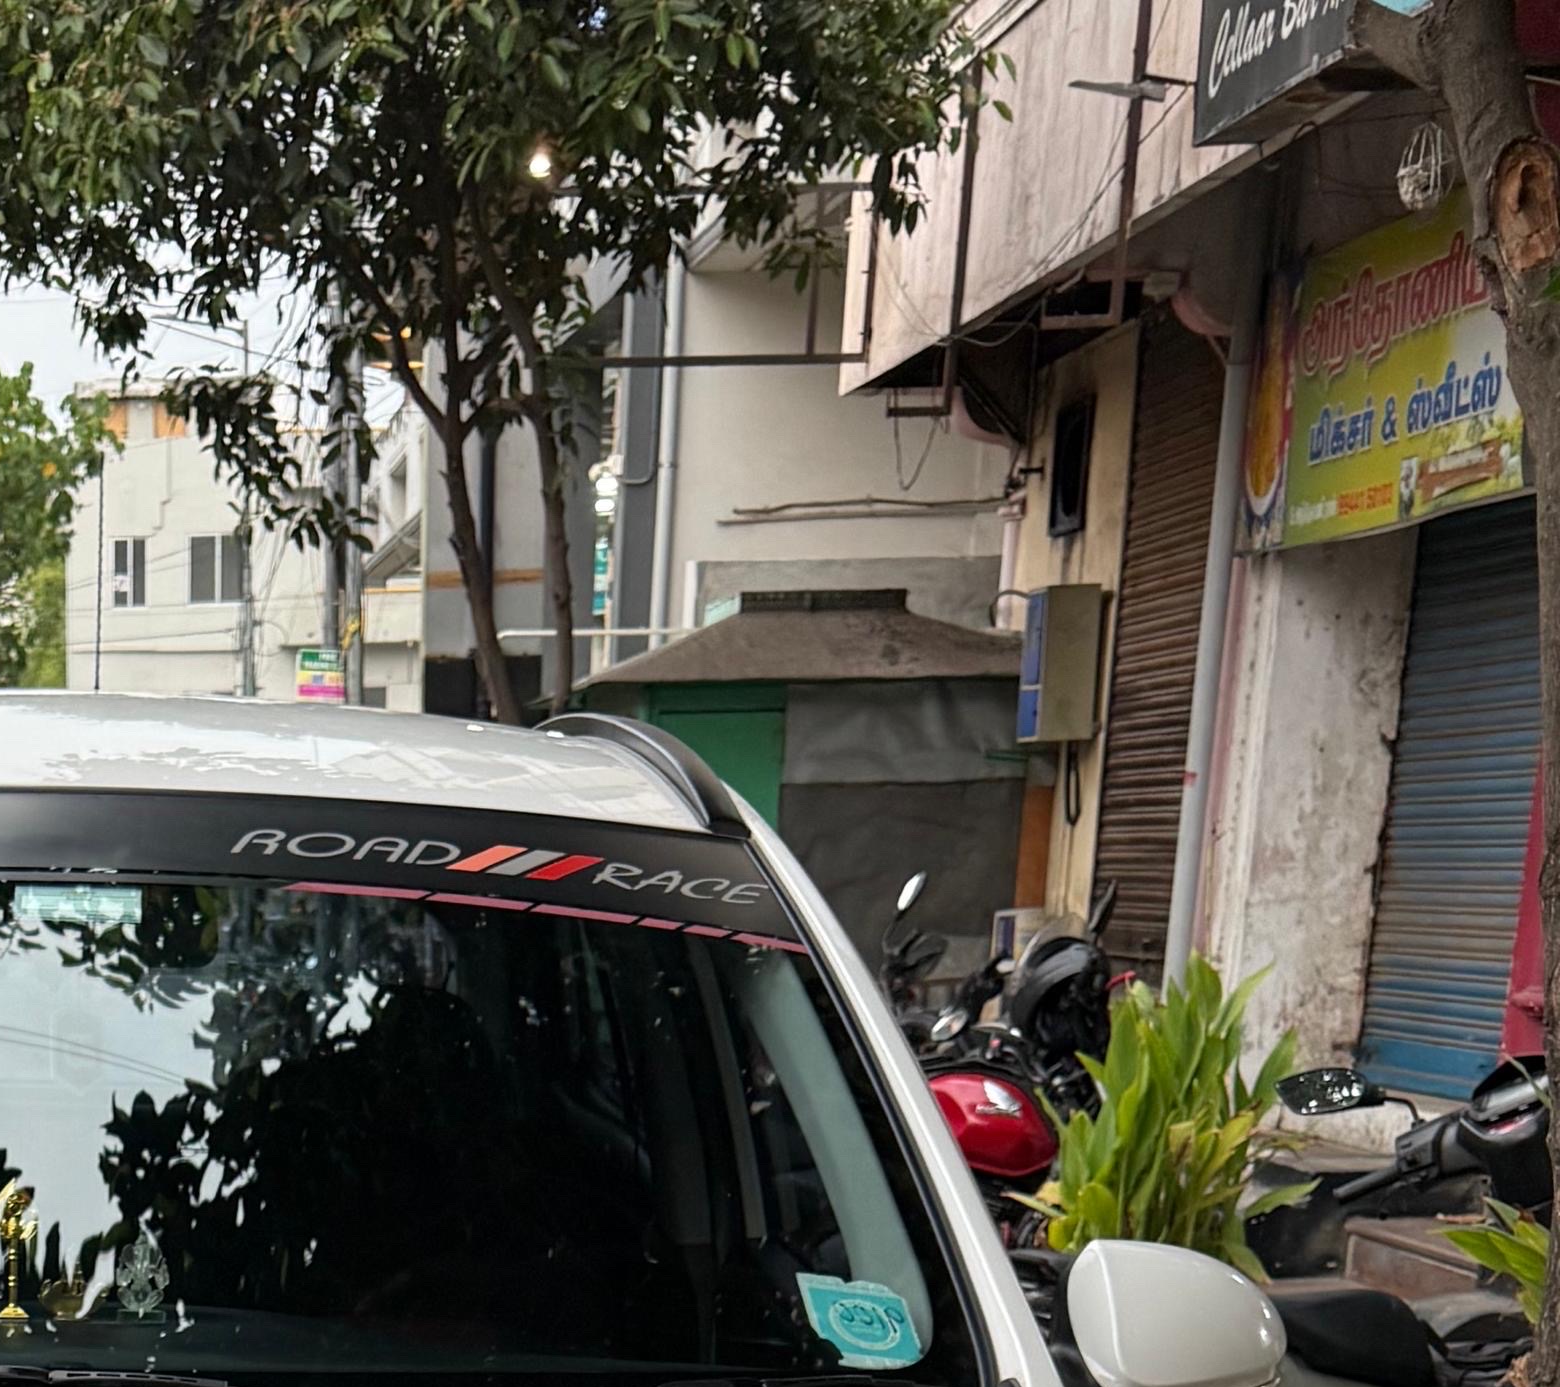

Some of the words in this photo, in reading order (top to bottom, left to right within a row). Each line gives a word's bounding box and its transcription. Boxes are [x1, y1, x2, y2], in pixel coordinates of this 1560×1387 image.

[1381, 397, 1397, 440] &
[230, 829, 461, 866] ROAD
[592, 861, 769, 905] RACE
